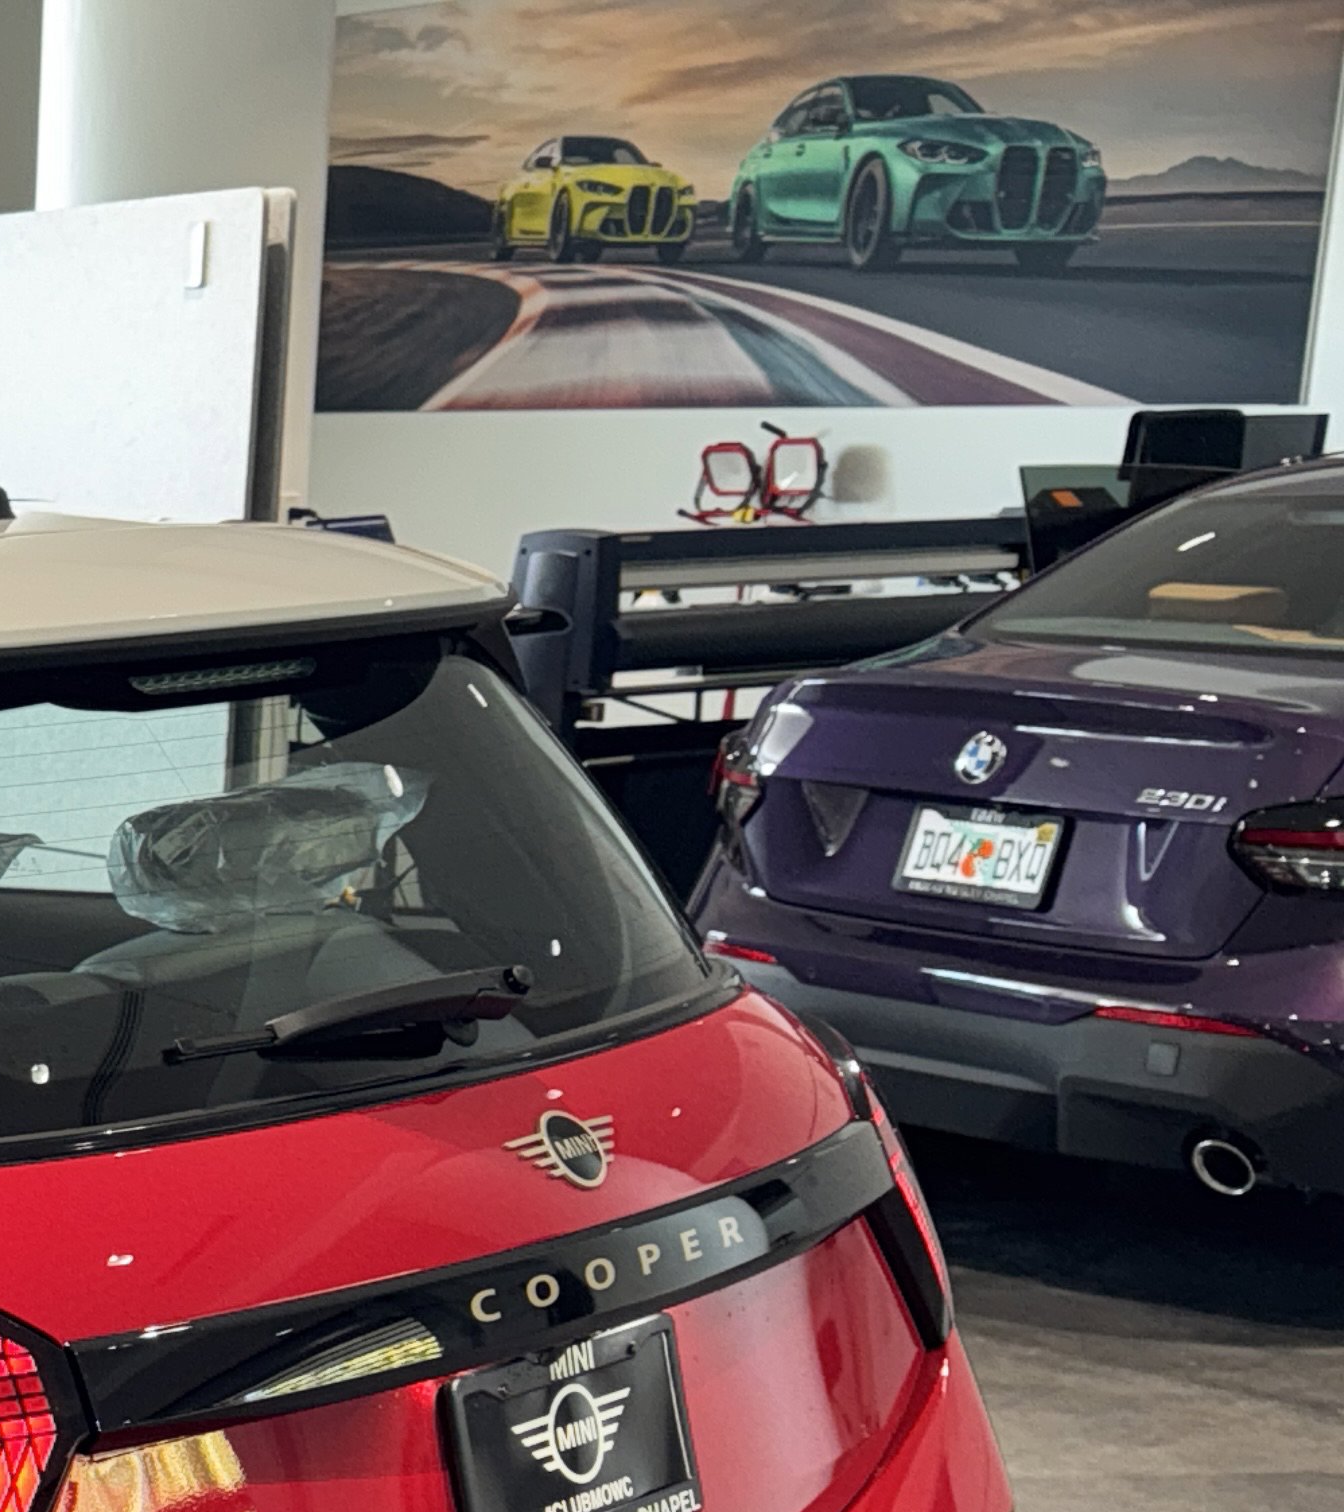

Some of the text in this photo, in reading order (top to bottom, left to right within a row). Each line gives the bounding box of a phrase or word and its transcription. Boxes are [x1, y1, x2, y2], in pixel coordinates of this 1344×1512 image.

[553, 1133, 599, 1160] MINI
[470, 1216, 744, 1322] COOPER
[549, 1339, 595, 1381] MINI
[555, 1416, 598, 1452] MINI
